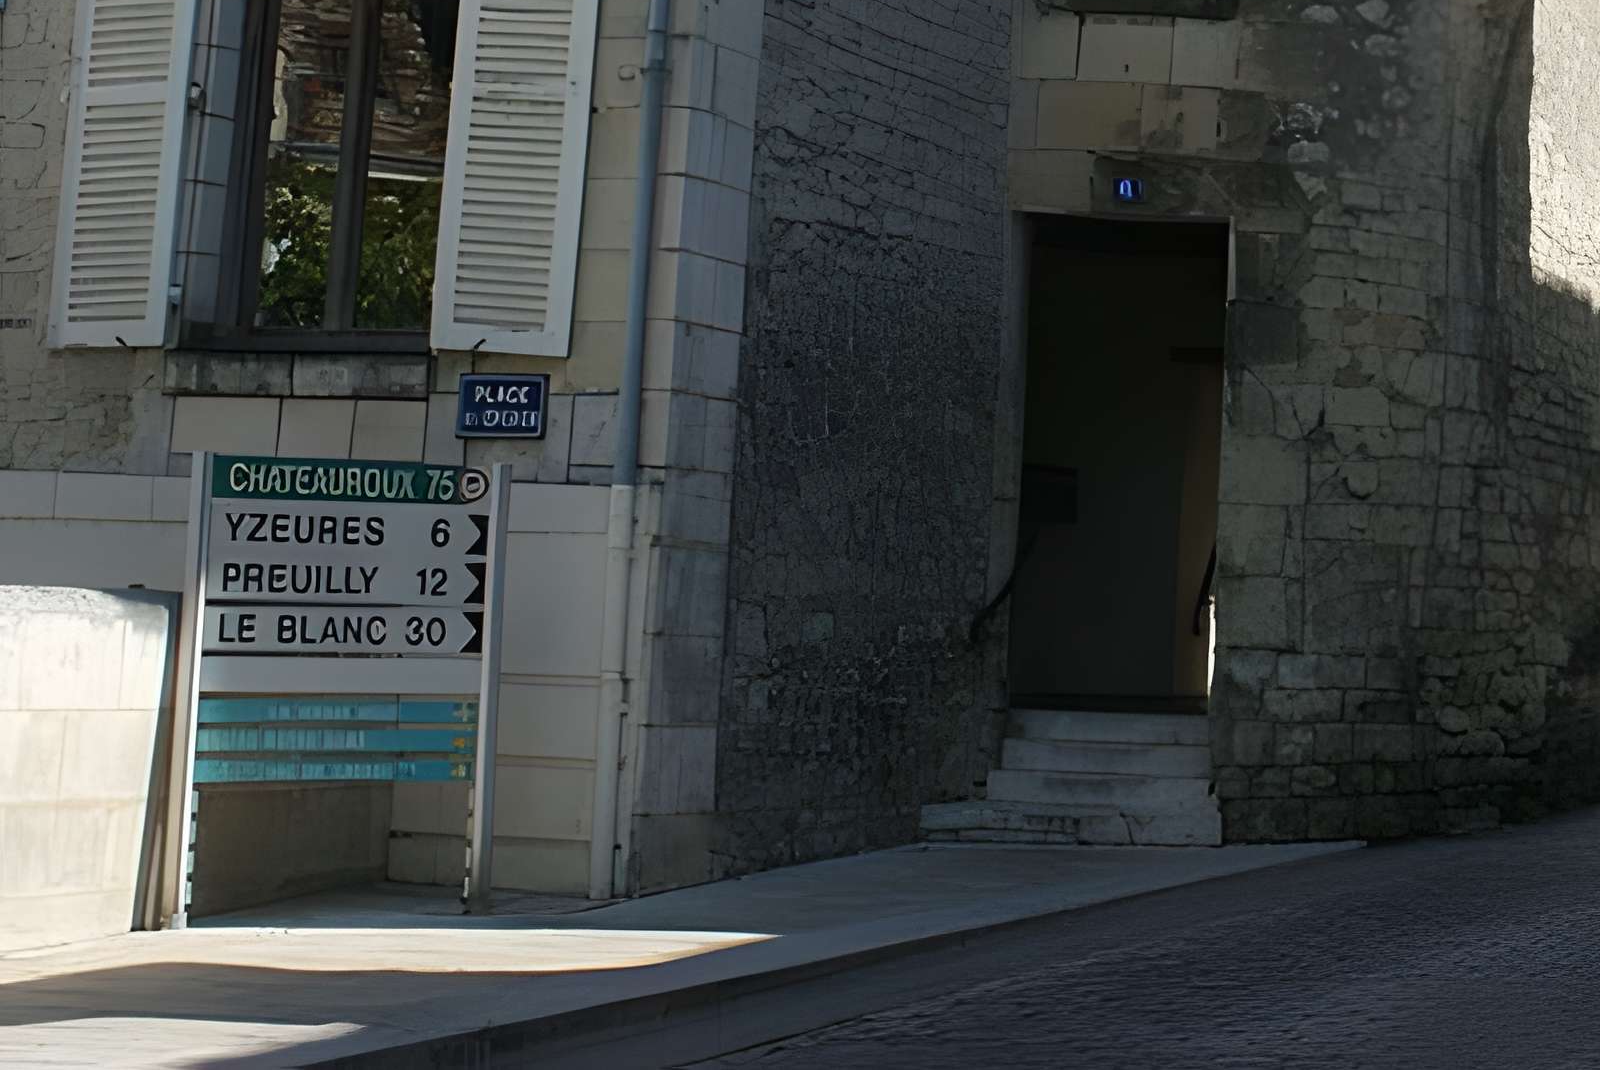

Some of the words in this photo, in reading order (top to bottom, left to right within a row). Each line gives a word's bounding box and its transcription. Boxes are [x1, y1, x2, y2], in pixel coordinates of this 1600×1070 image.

[225, 513, 385, 546] YZEURES
[430, 518, 451, 548] 6
[222, 563, 379, 595] PREUILLY
[416, 568, 449, 597] 12
[218, 613, 257, 643] LE
[277, 616, 387, 646] BLANC
[405, 616, 447, 647] 30
